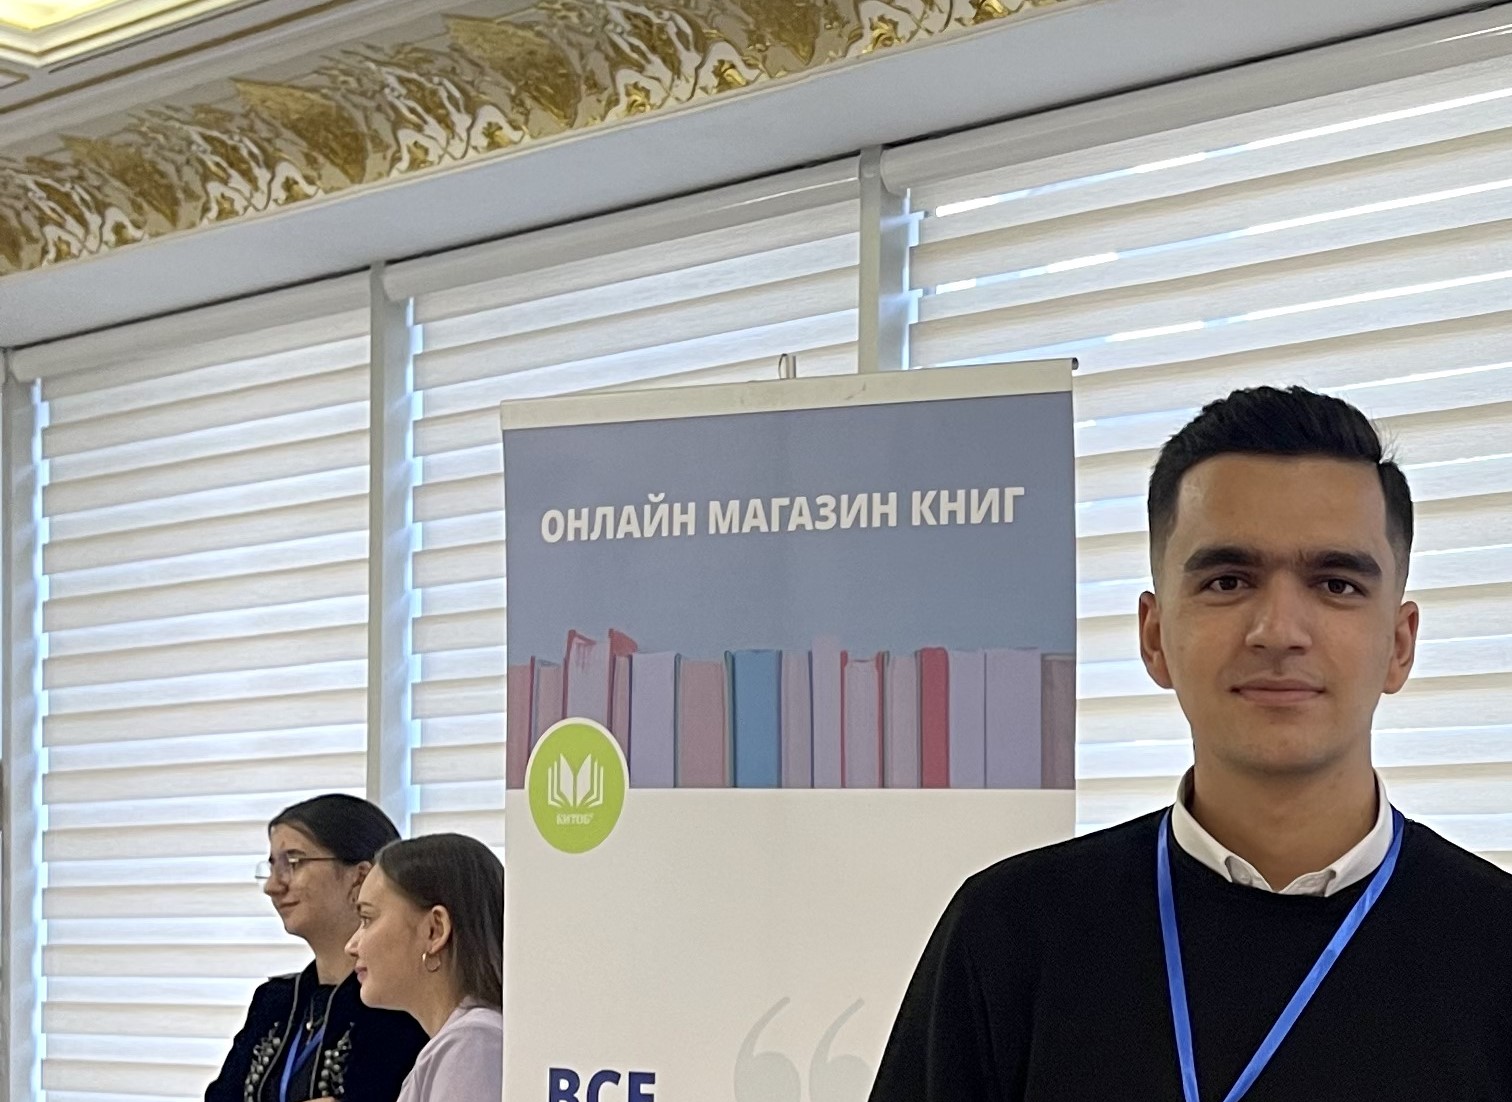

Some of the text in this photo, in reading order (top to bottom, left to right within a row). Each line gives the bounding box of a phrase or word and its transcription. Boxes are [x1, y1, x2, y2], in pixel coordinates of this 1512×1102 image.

[541, 486, 1025, 543] ОНЛАЙН МАГАЗИН КНИГ
